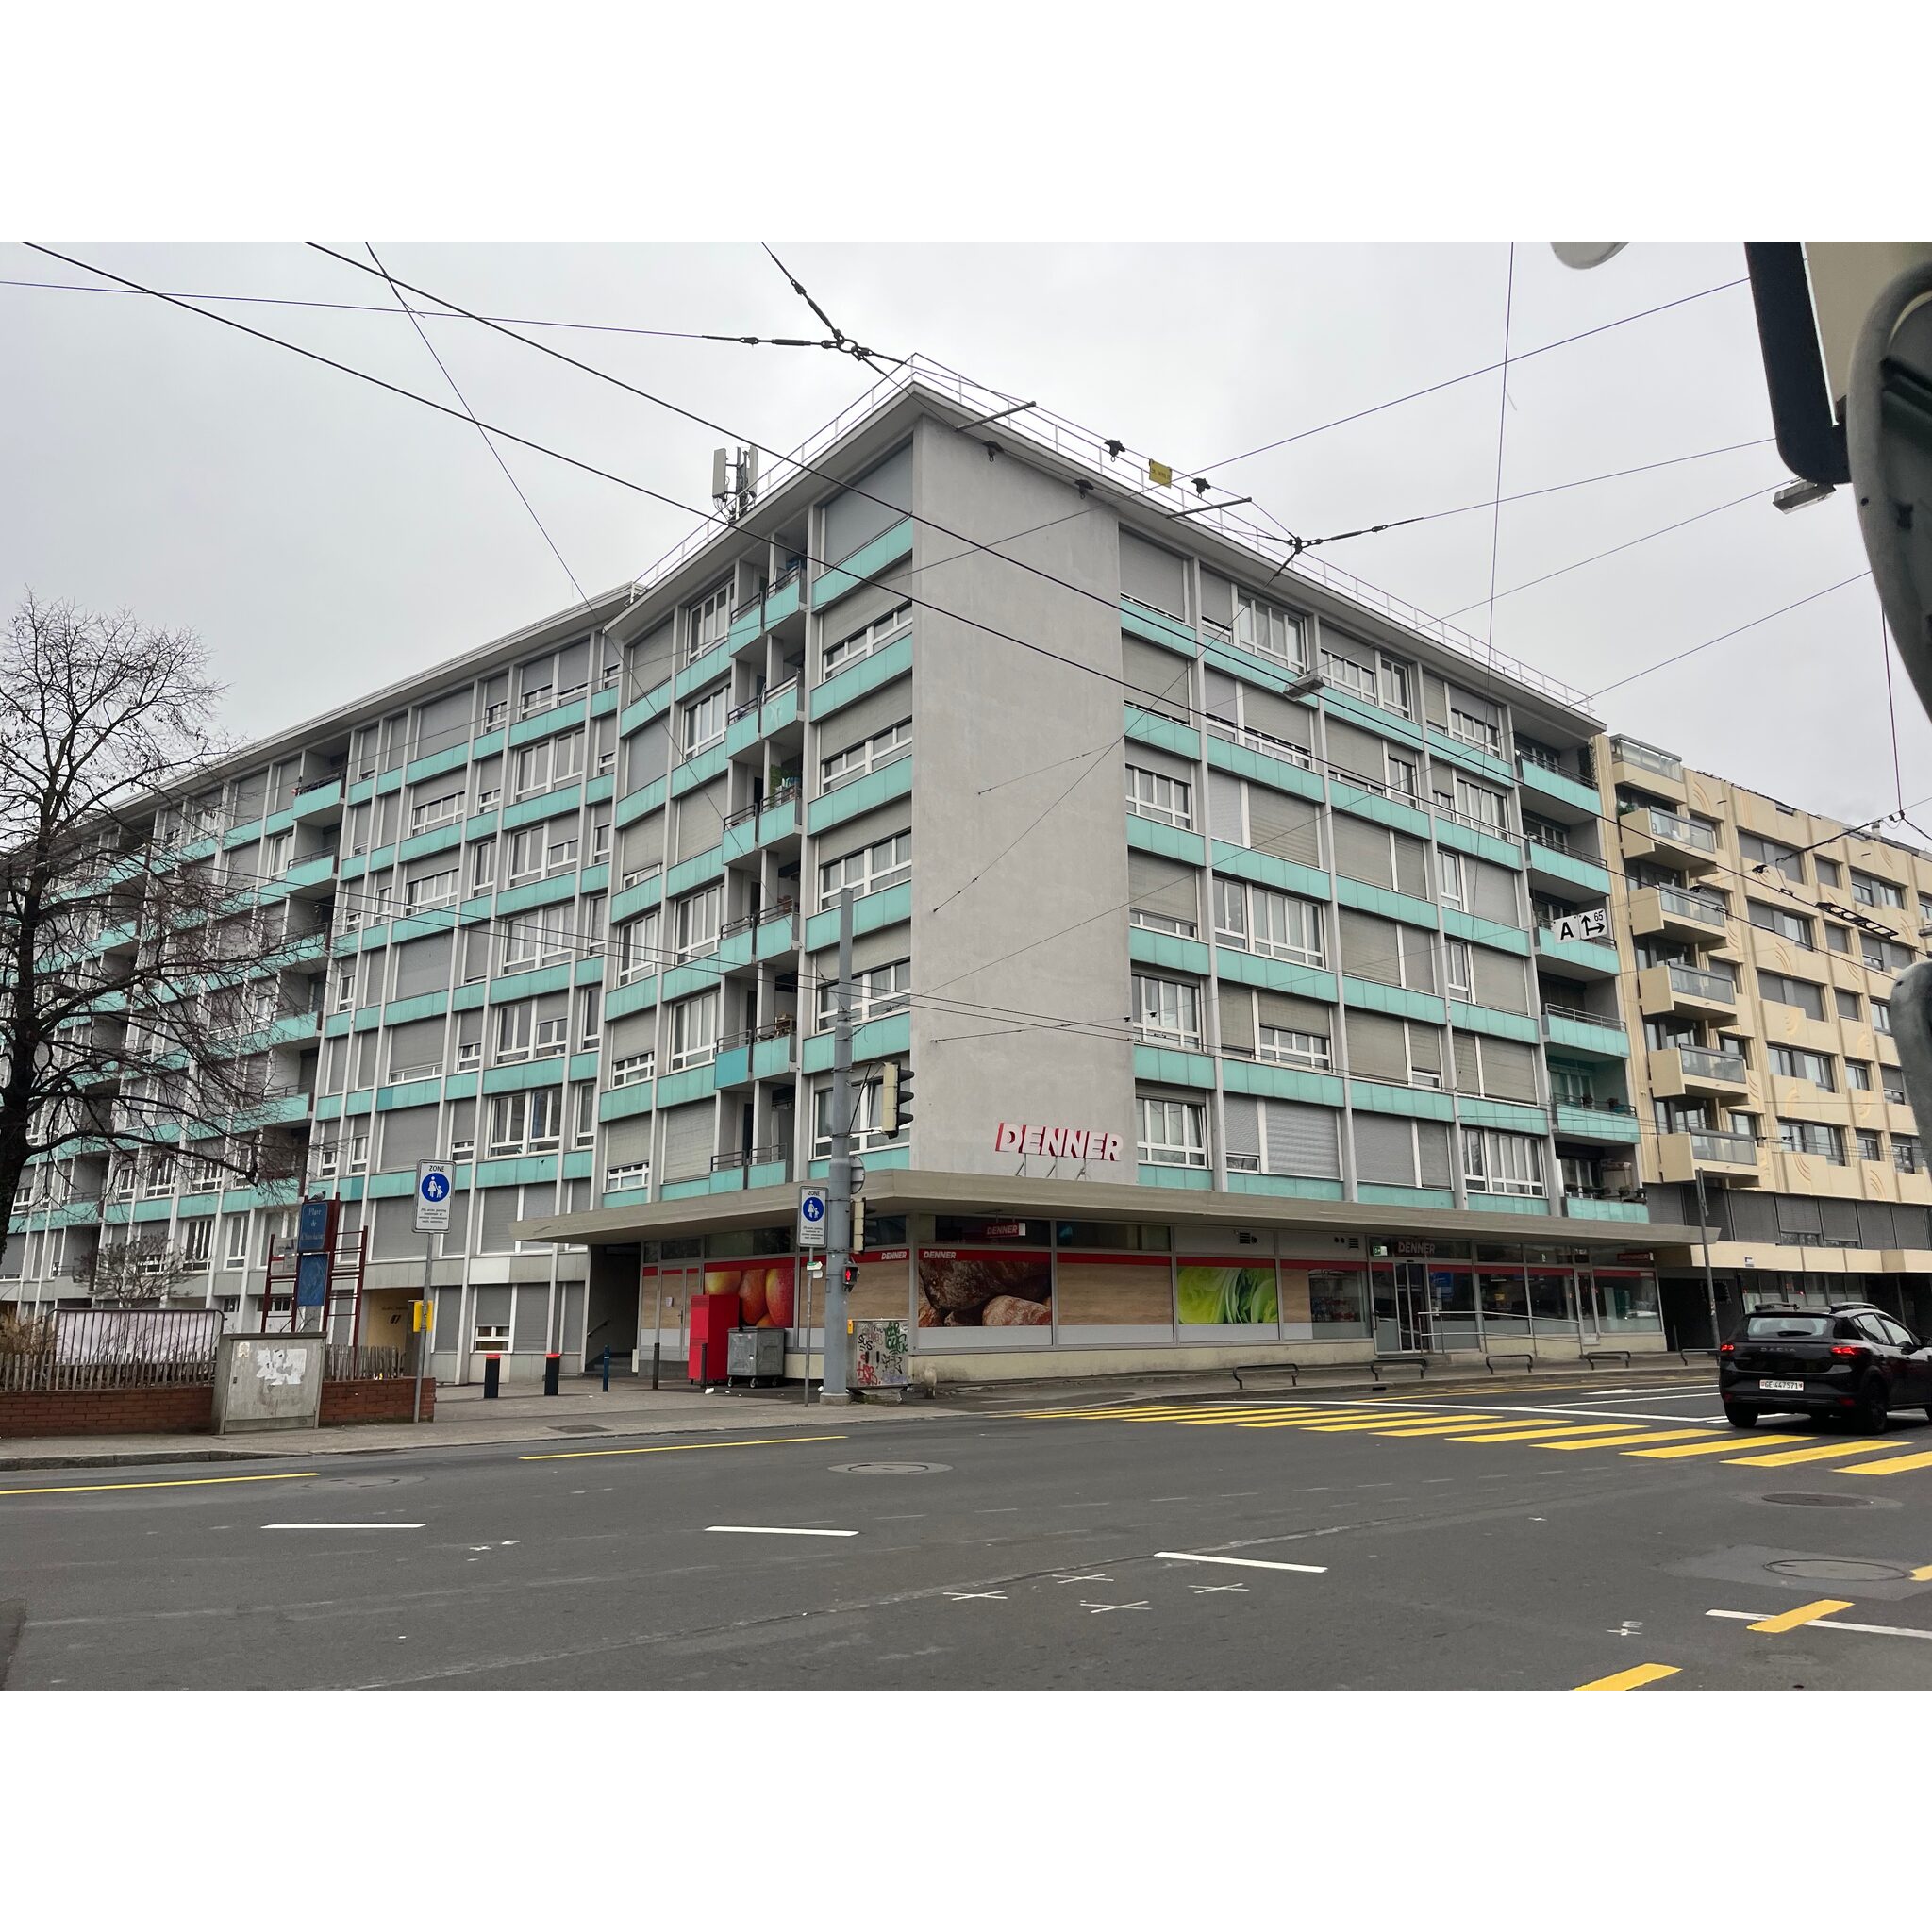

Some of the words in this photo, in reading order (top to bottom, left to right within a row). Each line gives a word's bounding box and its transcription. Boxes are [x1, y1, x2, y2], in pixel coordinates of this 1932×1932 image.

[1560, 922, 1574, 941] A
[1594, 910, 1603, 922] 65
[995, 1123, 1124, 1161] DENNER
[987, 1225, 1018, 1235] DENNER
[1398, 1242, 1435, 1254] DENNER
[881, 1251, 907, 1260] DENNER
[923, 1251, 957, 1259] DENNER
